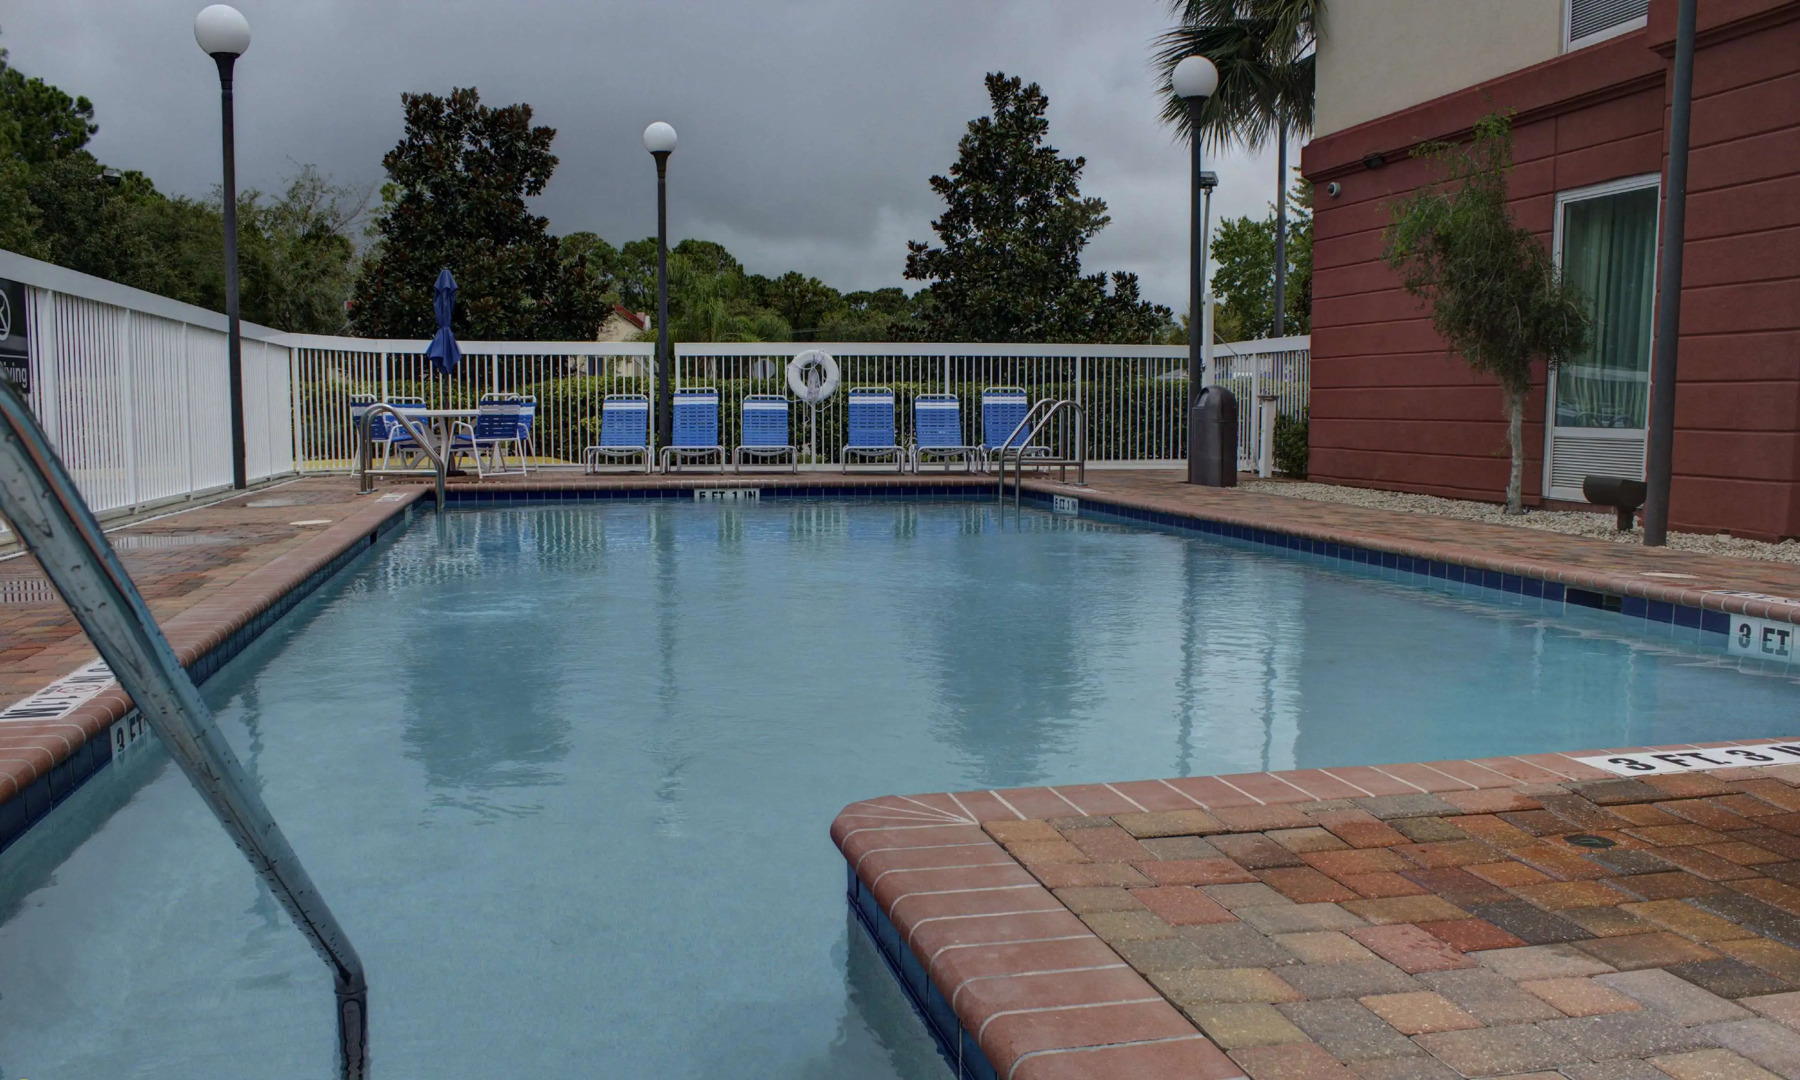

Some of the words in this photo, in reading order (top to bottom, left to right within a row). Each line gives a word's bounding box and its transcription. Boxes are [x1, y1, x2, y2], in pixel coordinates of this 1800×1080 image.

[1608, 757, 1656, 771] 3
[1725, 749, 1774, 761] 3
[1768, 745, 1800, 756] I
